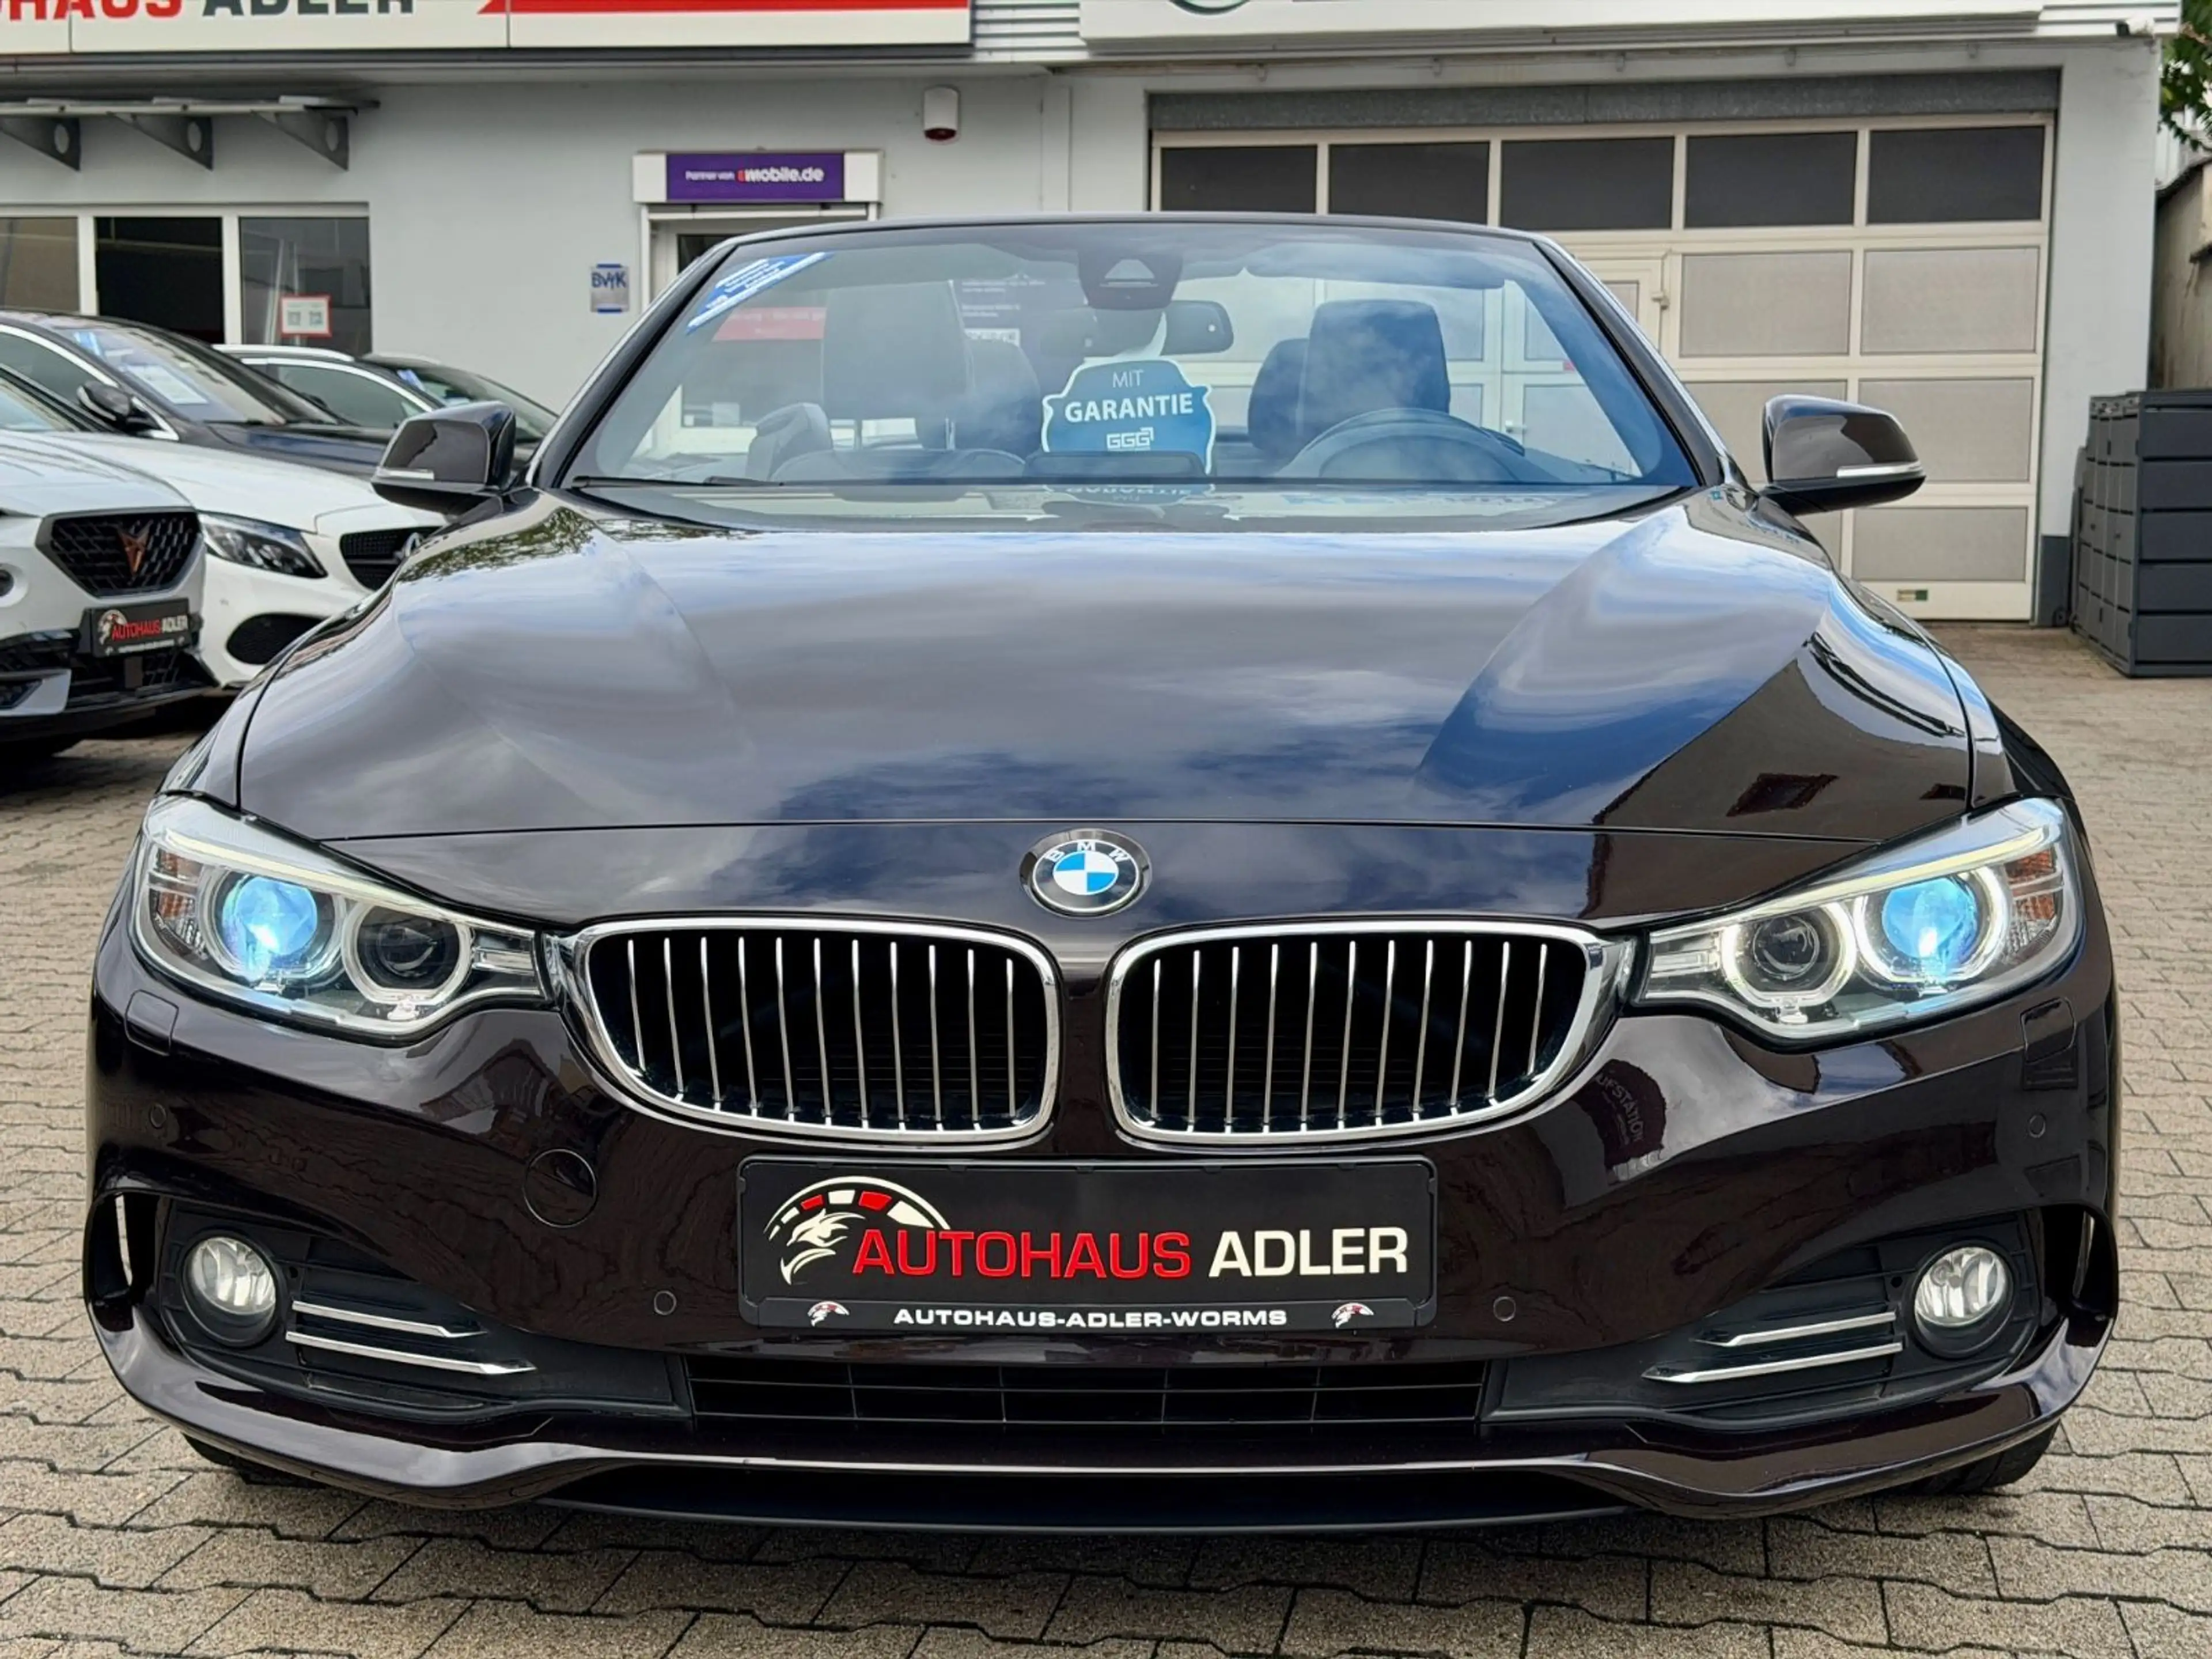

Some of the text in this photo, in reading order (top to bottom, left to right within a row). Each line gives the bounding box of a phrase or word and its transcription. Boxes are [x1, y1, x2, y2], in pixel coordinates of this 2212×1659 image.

[1113, 369, 1144, 388] MIT
[1065, 393, 1194, 423] GARANTIE
[1107, 427, 1154, 448] GGG
[112, 620, 161, 641] AUTOHAUS
[1044, 840, 1130, 862] BMW
[852, 1227, 1408, 1279] AUTOHAUS ADLER
[894, 1309, 1287, 1327] AUTOHAUS-ADLER-WORMS
